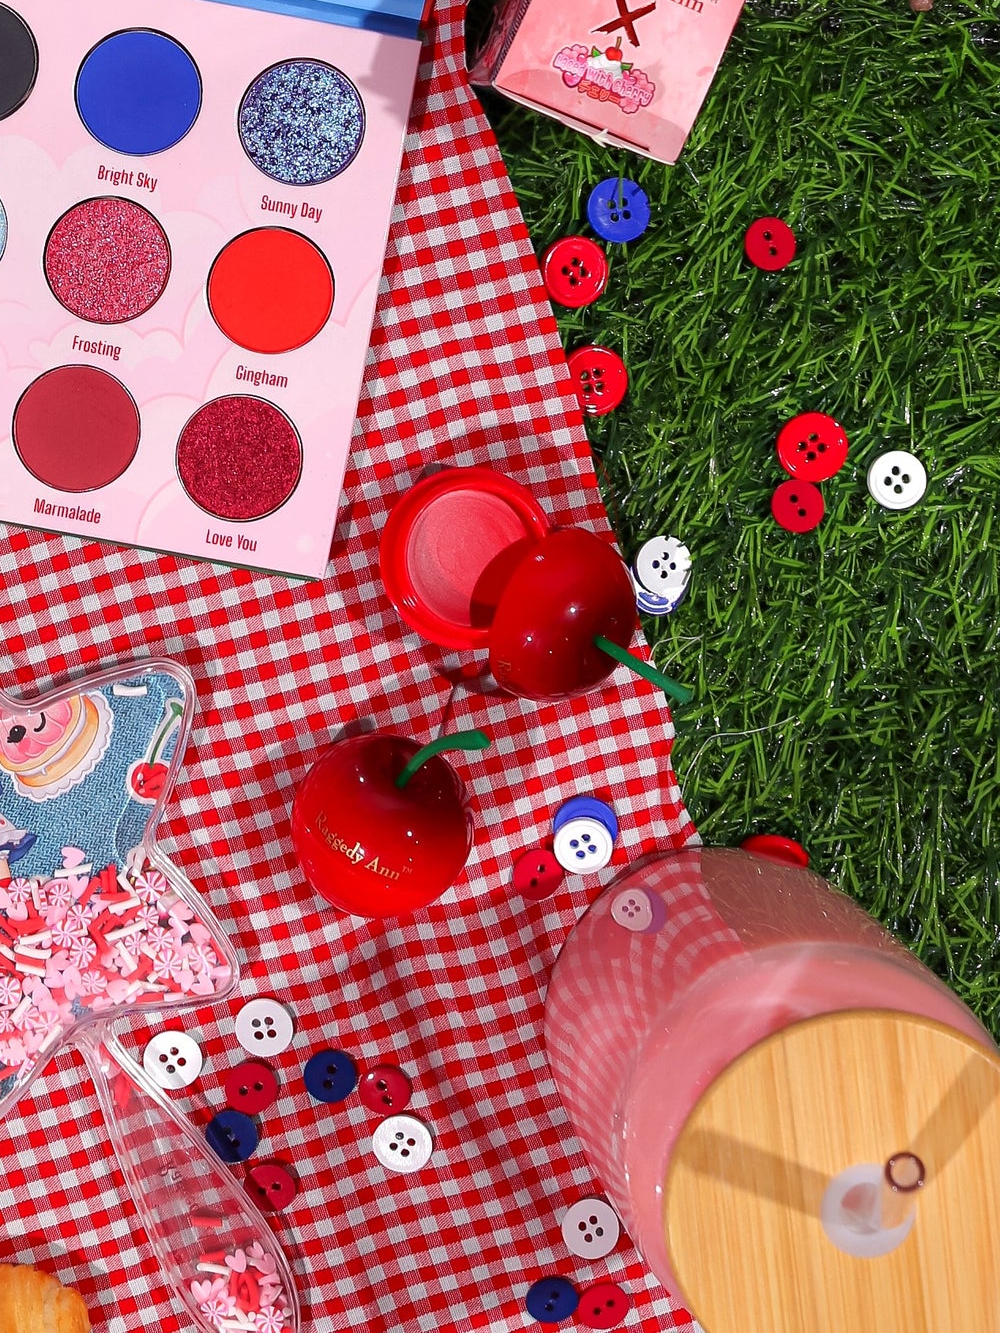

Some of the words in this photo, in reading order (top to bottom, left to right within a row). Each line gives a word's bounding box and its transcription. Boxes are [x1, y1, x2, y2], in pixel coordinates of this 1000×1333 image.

[98, 165, 133, 187] Bright
[137, 172, 158, 193] Sky
[261, 195, 298, 218] Sunny
[301, 202, 323, 223] Day
[72, 335, 121, 361] Frosting
[235, 365, 288, 388] Gingham
[33, 497, 101, 524] Marmalade
[206, 529, 232, 547] Love
[237, 534, 257, 552] You
[315, 810, 365, 864] Raggedy
